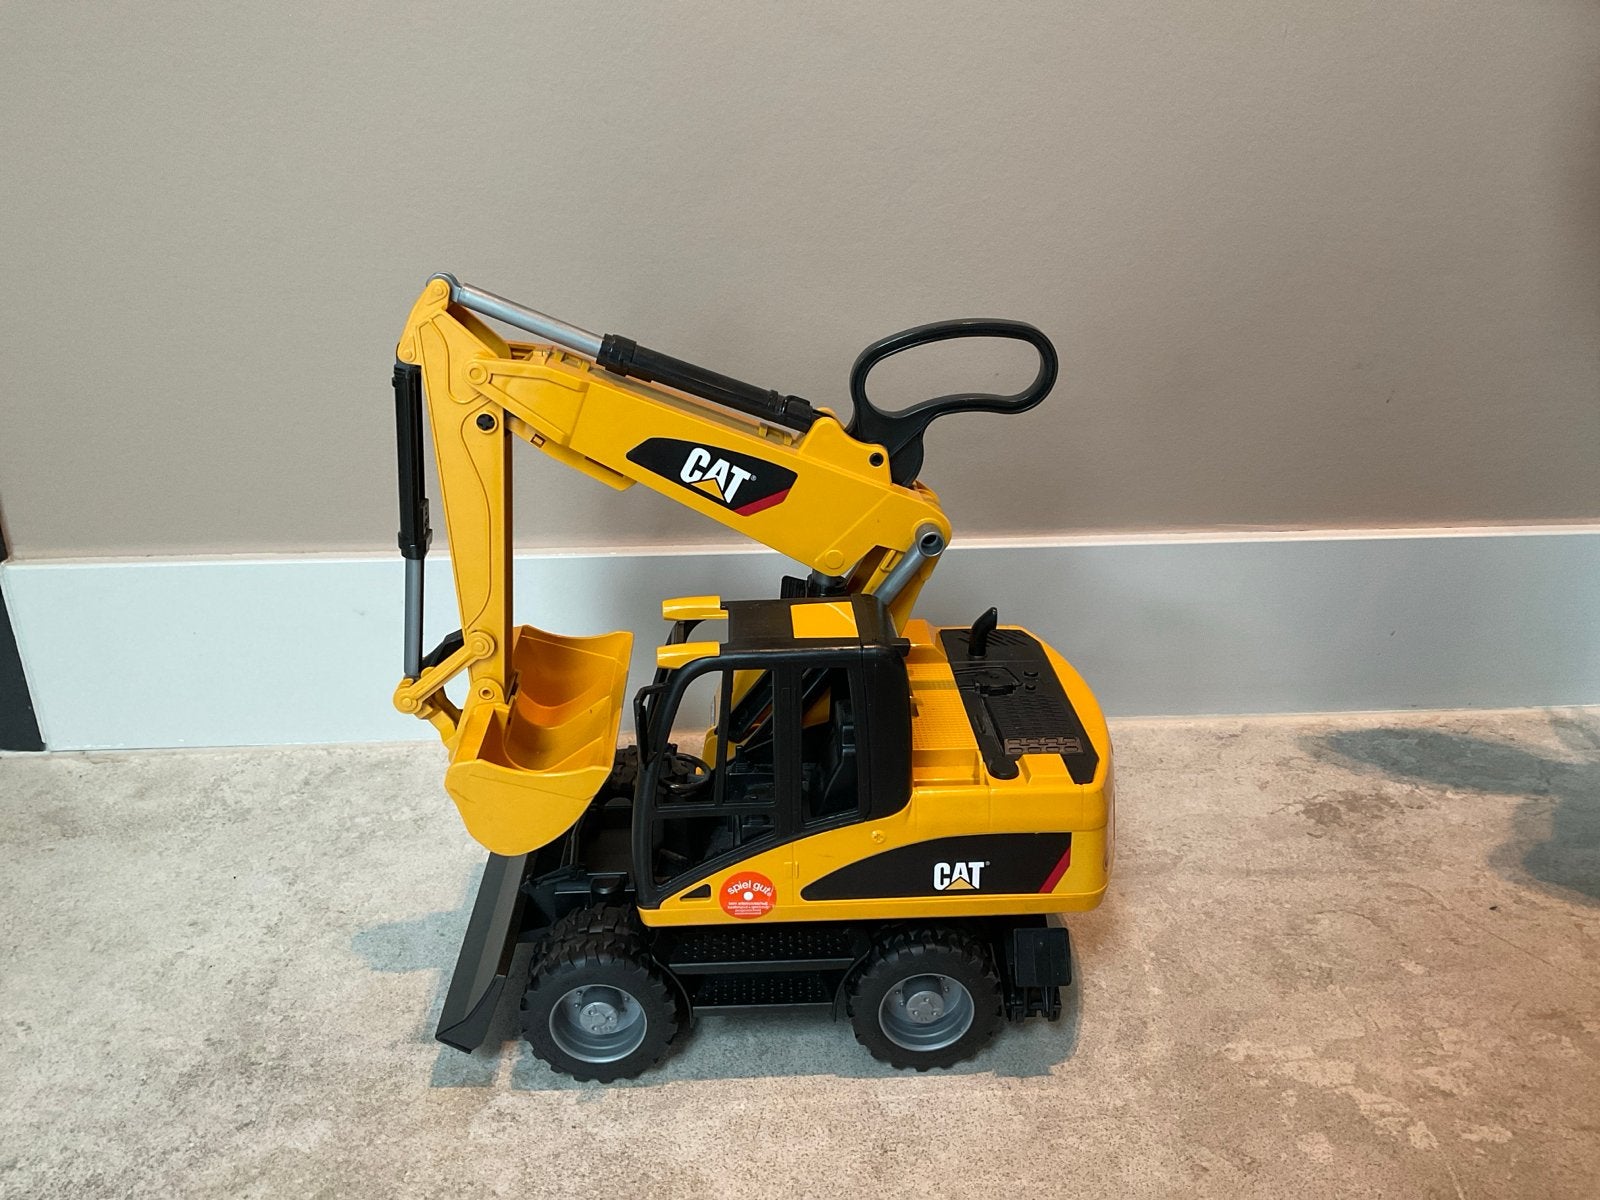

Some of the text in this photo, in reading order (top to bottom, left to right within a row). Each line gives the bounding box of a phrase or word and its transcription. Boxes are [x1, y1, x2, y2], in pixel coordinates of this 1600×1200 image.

[680, 447, 752, 504] CAT
[727, 880, 752, 895] spiel
[933, 861, 985, 891] CAT
